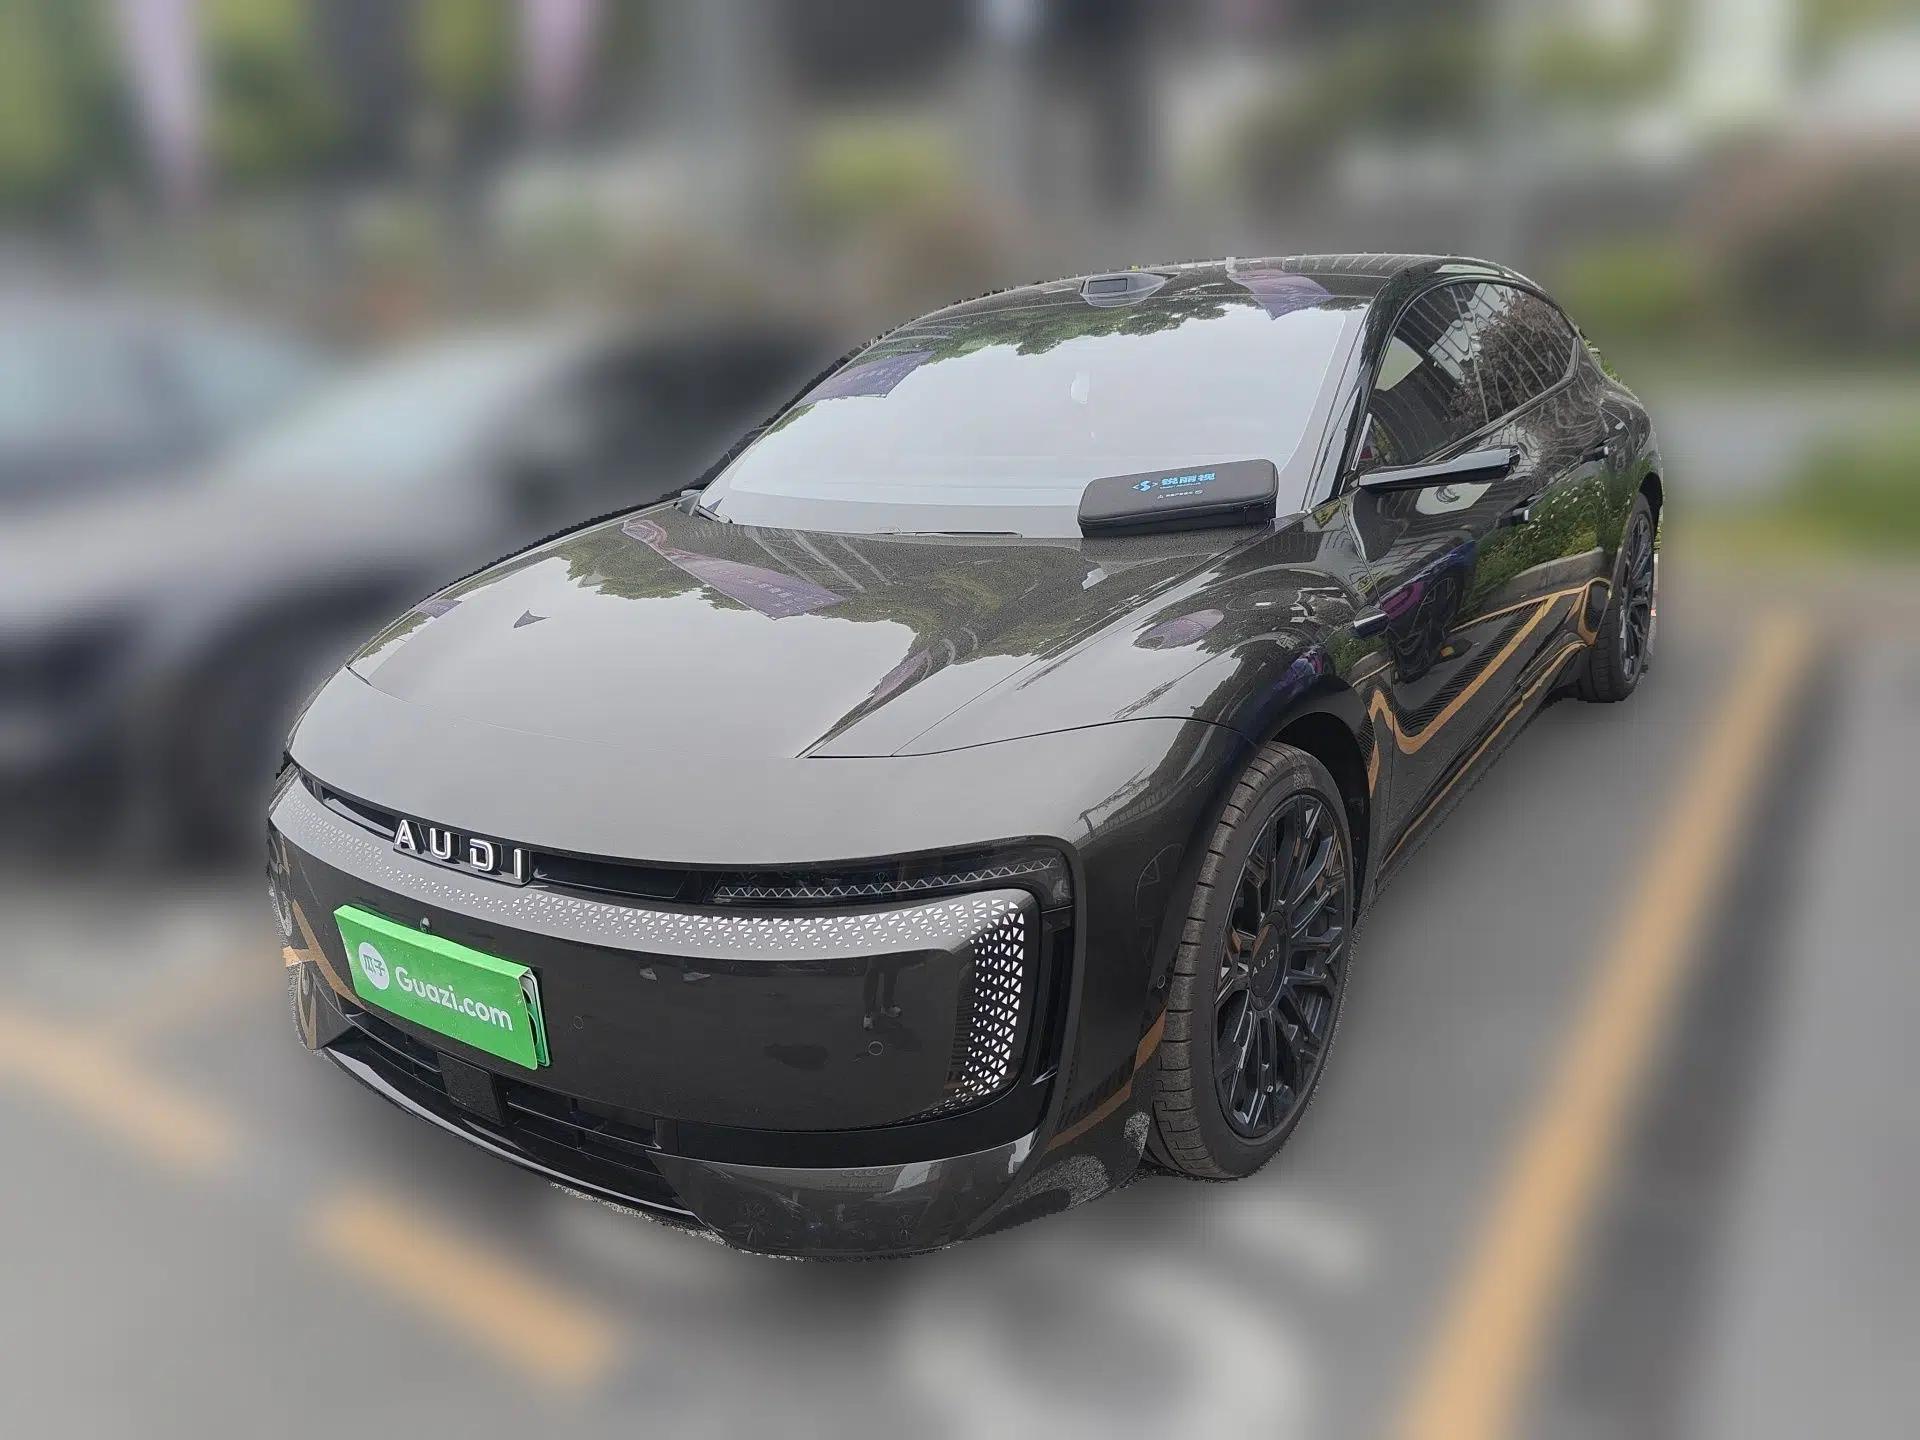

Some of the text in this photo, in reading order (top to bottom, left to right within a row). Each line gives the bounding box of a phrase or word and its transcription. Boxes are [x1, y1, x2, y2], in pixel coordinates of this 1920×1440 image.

[393, 819, 523, 880] AUDI
[1252, 943, 1279, 977] AUDI
[395, 966, 514, 1031] Guazi.com
